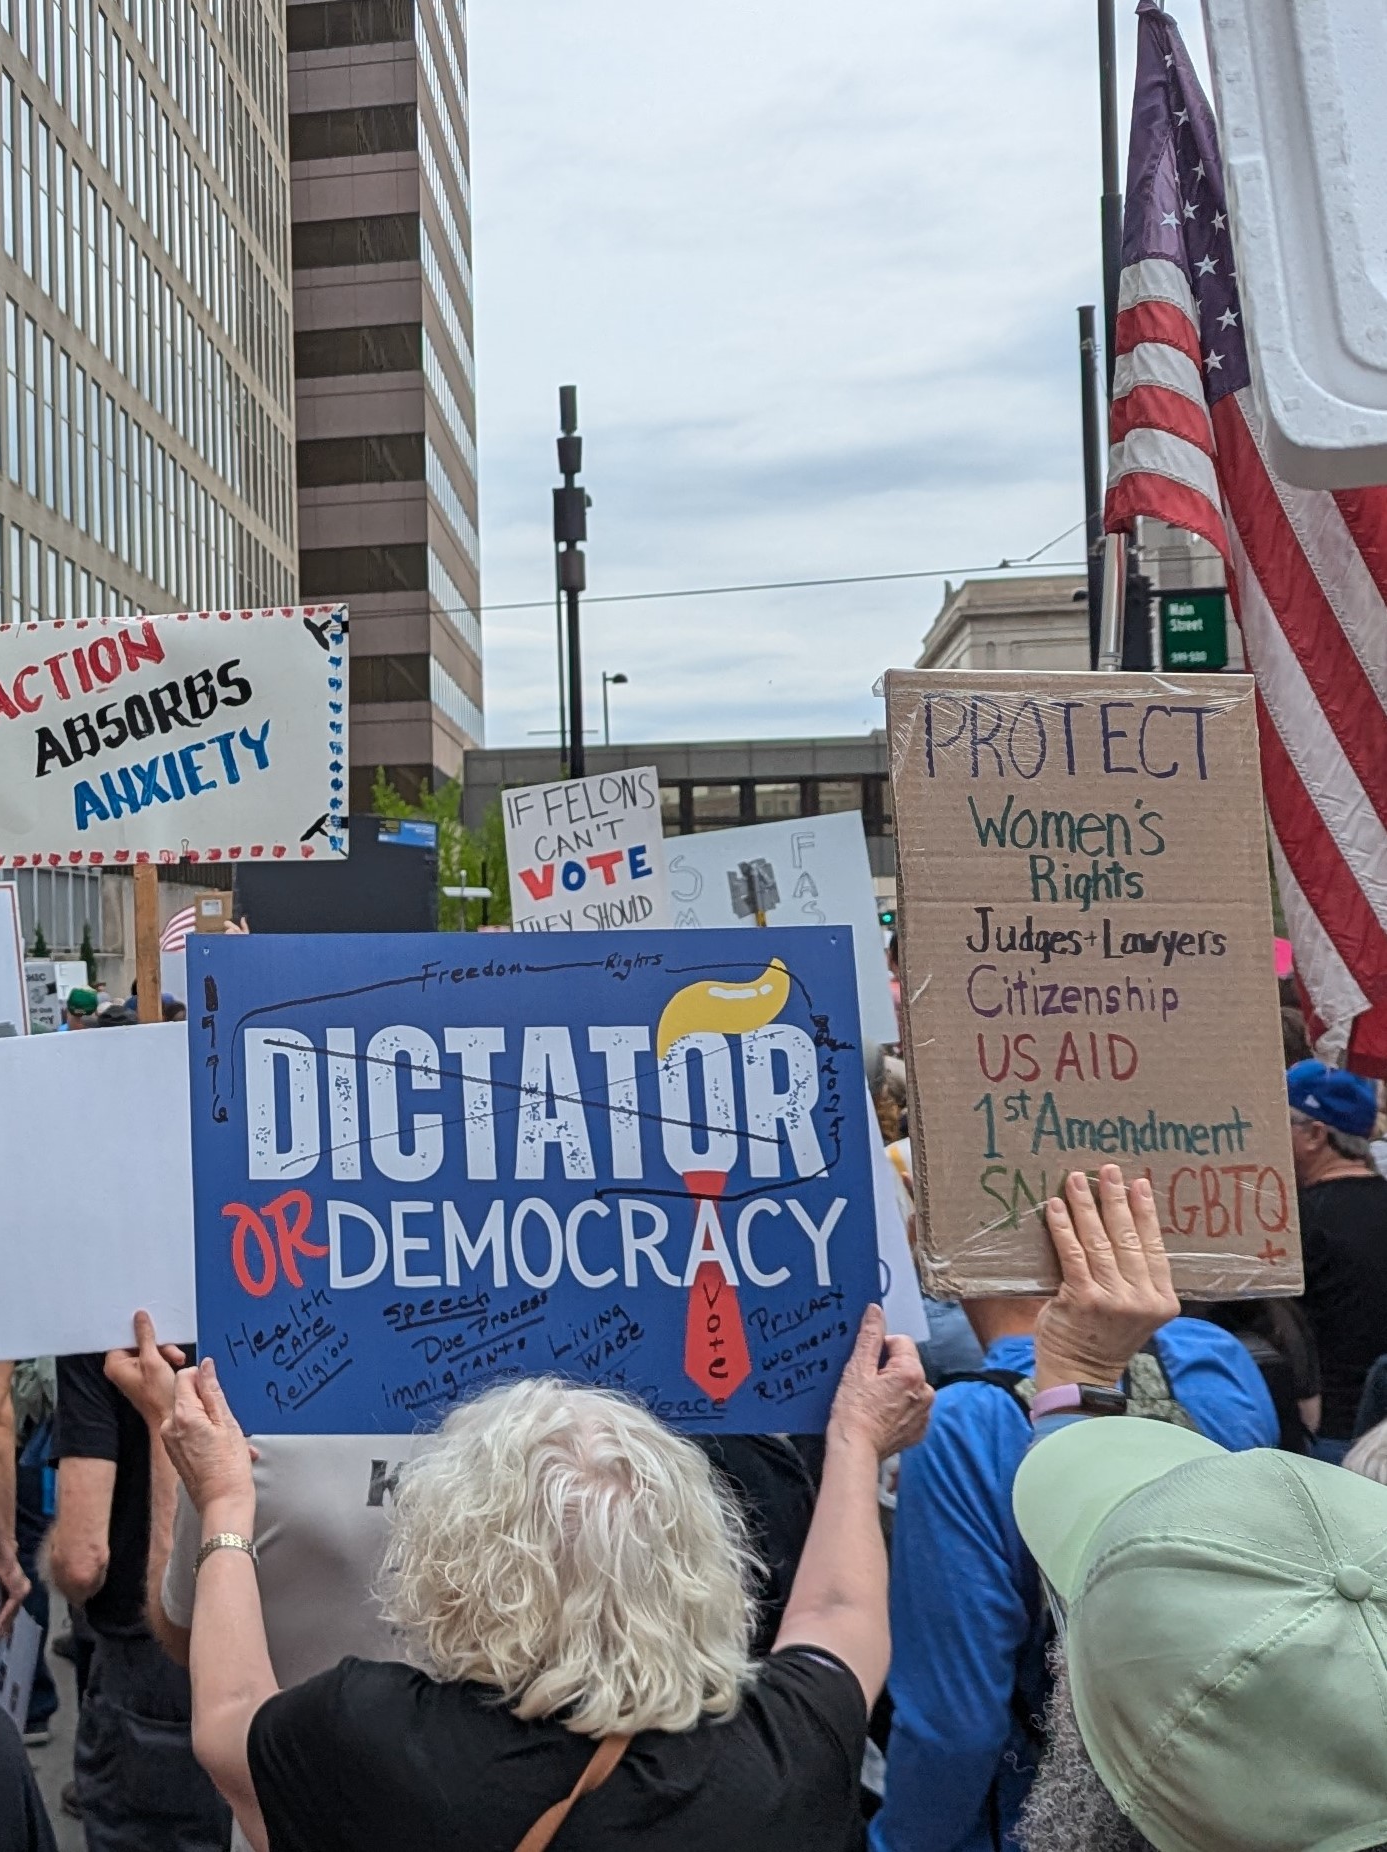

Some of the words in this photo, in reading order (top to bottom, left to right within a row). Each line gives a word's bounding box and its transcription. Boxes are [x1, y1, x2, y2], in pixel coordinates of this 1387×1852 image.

[1170, 618, 1204, 632] Street
[34, 658, 254, 778] ABSORBS
[922, 692, 1213, 781] PROTECT
[73, 719, 271, 831] ANXIETY
[507, 792, 534, 829] IF
[543, 772, 655, 826] FELONS
[534, 818, 624, 862] CAN'T
[967, 794, 1166, 858] Women's
[518, 844, 653, 901] VOTE
[1029, 854, 1144, 913] Rights
[583, 894, 653, 931] SHOULD
[420, 957, 523, 993] Freedom
[966, 964, 1180, 1023] Citizenship
[244, 1022, 831, 1182] DICTATOR
[974, 1089, 1031, 1159] 1st
[1031, 1091, 1253, 1157] Amendment
[221, 1188, 329, 1298] OR
[329, 1196, 848, 1291] DEMOCRACY
[225, 1288, 333, 1367] Health
[411, 1333, 466, 1365] Due
